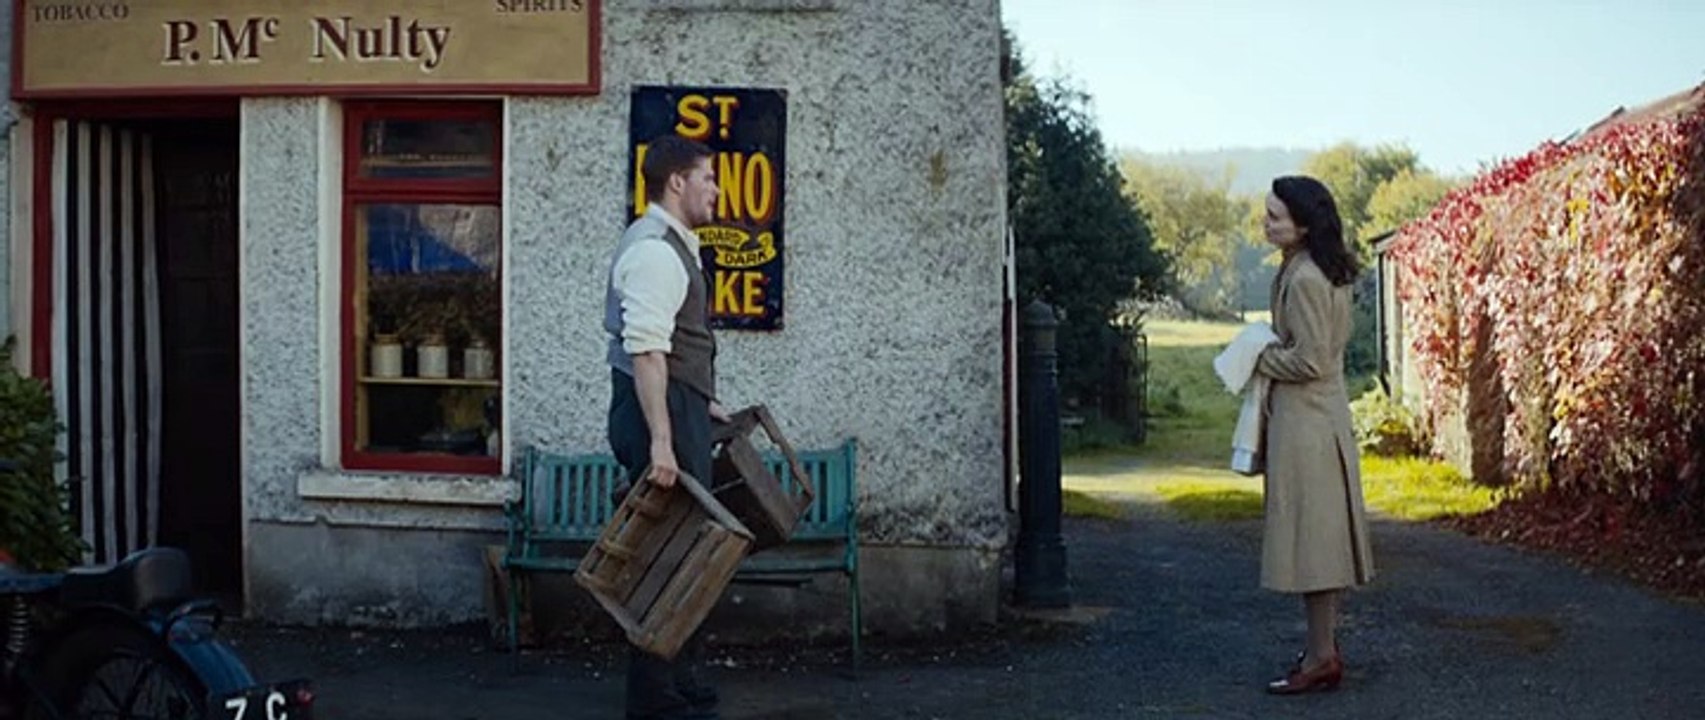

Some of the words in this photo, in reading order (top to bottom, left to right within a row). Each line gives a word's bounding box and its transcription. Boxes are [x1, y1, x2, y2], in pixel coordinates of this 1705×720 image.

[31, 4, 129, 22] TOBACCO
[309, 16, 451, 72] Nulty
[725, 251, 768, 264] DARK
